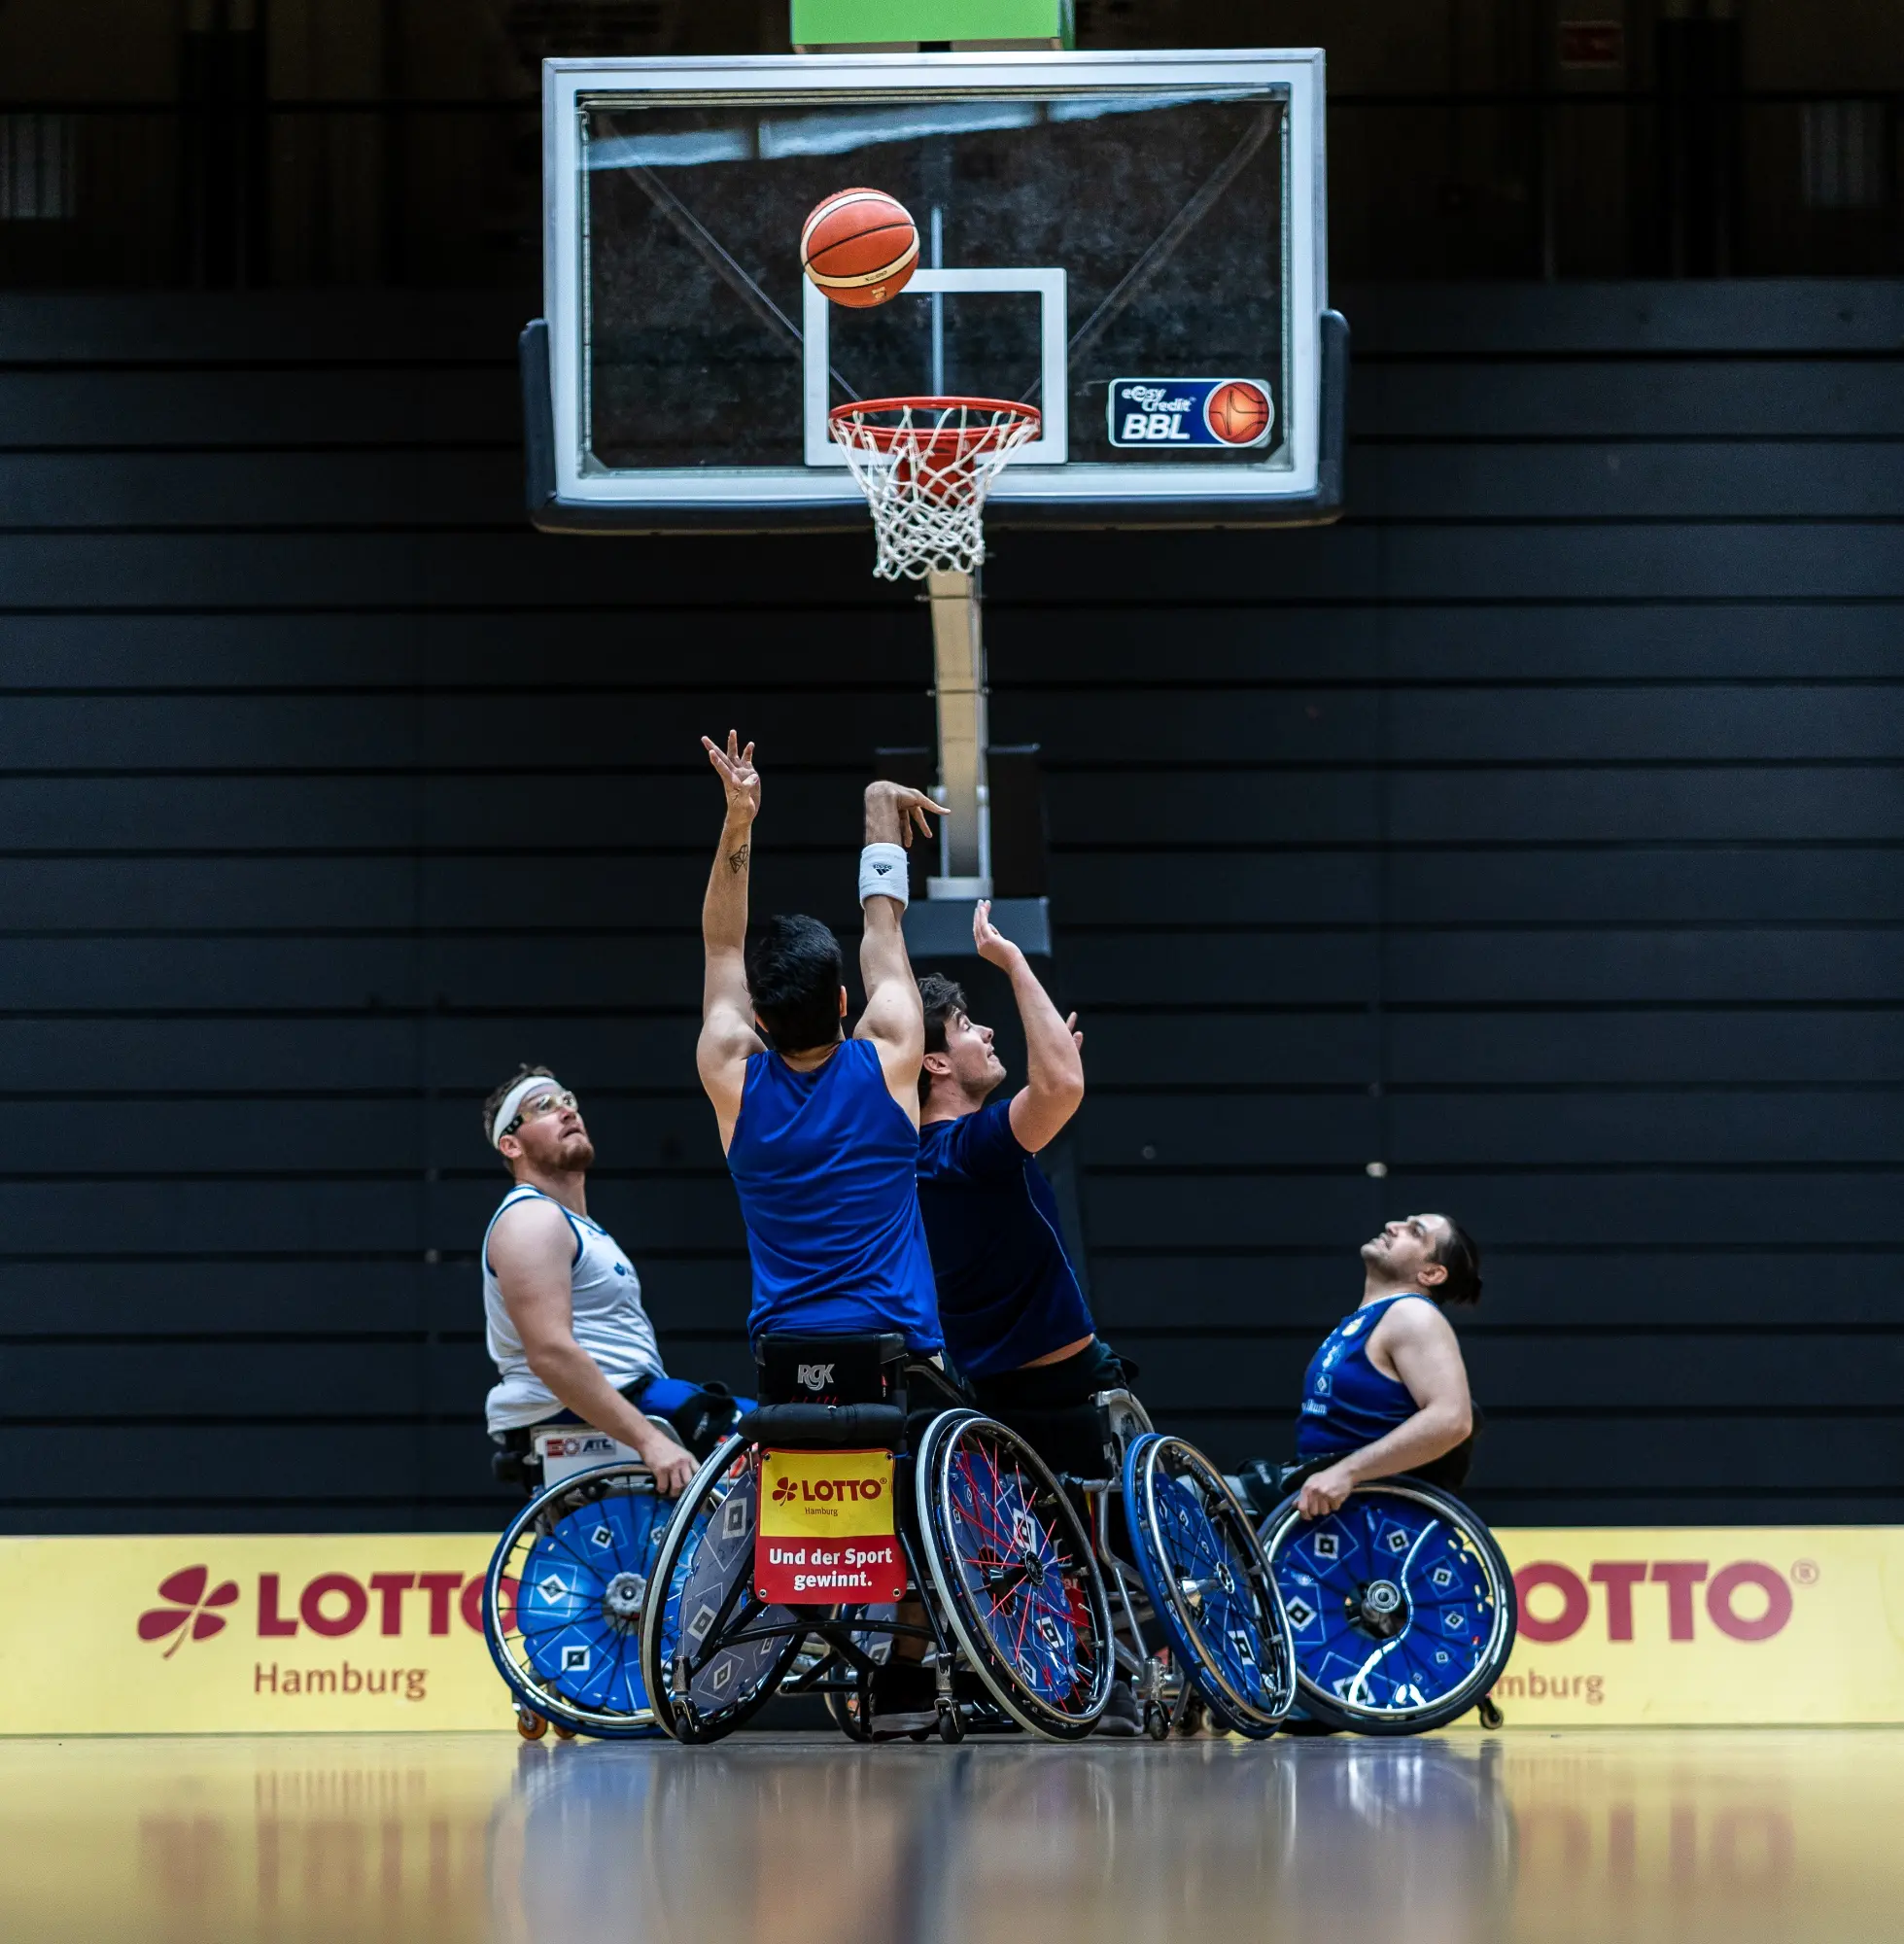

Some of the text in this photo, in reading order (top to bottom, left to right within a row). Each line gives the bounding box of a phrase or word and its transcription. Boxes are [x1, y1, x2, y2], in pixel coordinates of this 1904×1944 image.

[1122, 413, 1190, 439] BBL
[805, 1507, 839, 1516] Hamburg
[769, 1547, 892, 1568] Und der Sport
[793, 1571, 873, 1591] gewinnt.
[254, 1662, 429, 1701] Hamburg
[1497, 1668, 1605, 1706] mburg
